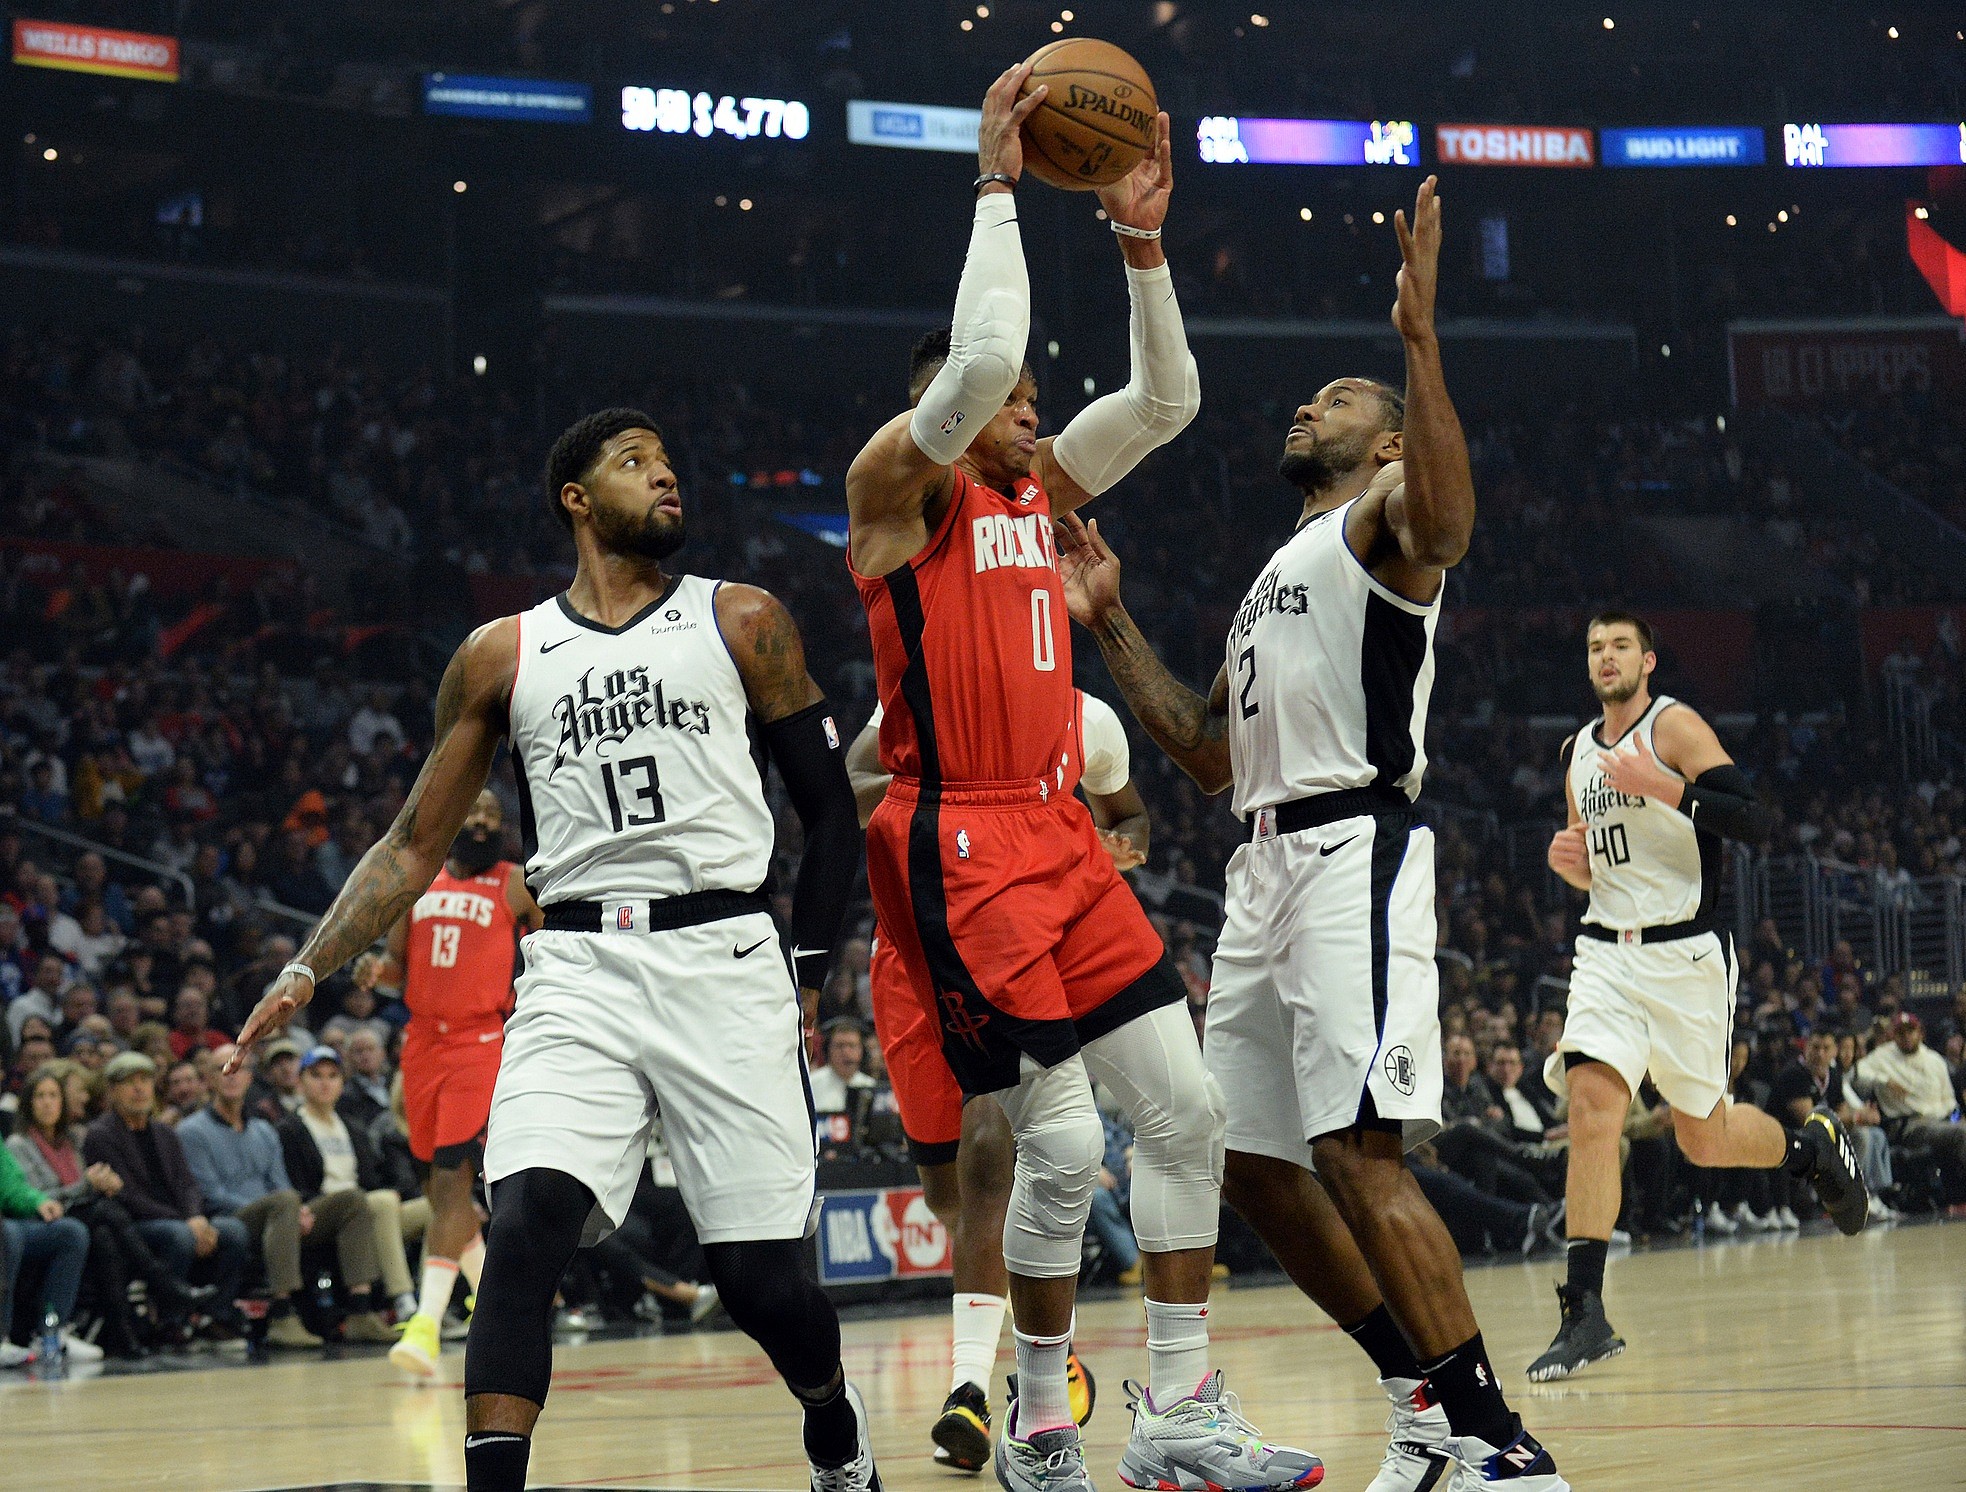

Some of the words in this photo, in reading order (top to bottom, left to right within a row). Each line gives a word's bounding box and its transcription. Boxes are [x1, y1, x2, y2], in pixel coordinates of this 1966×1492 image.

[22, 29, 96, 59] WELLS
[98, 37, 169, 68] FARGO
[1064, 84, 1154, 141] SPALDING
[1438, 129, 1590, 163] TOSHIBA
[1624, 137, 1673, 160] BUD
[1675, 137, 1740, 160] LIGHT
[651, 621, 697, 635] bumble
[1031, 588, 1055, 672] 0
[576, 665, 648, 711] Los
[1238, 645, 1259, 720] 2
[550, 679, 710, 782] Angeles
[601, 755, 665, 833] 13
[1592, 823, 1630, 867] 40
[431, 923, 461, 968] 13
